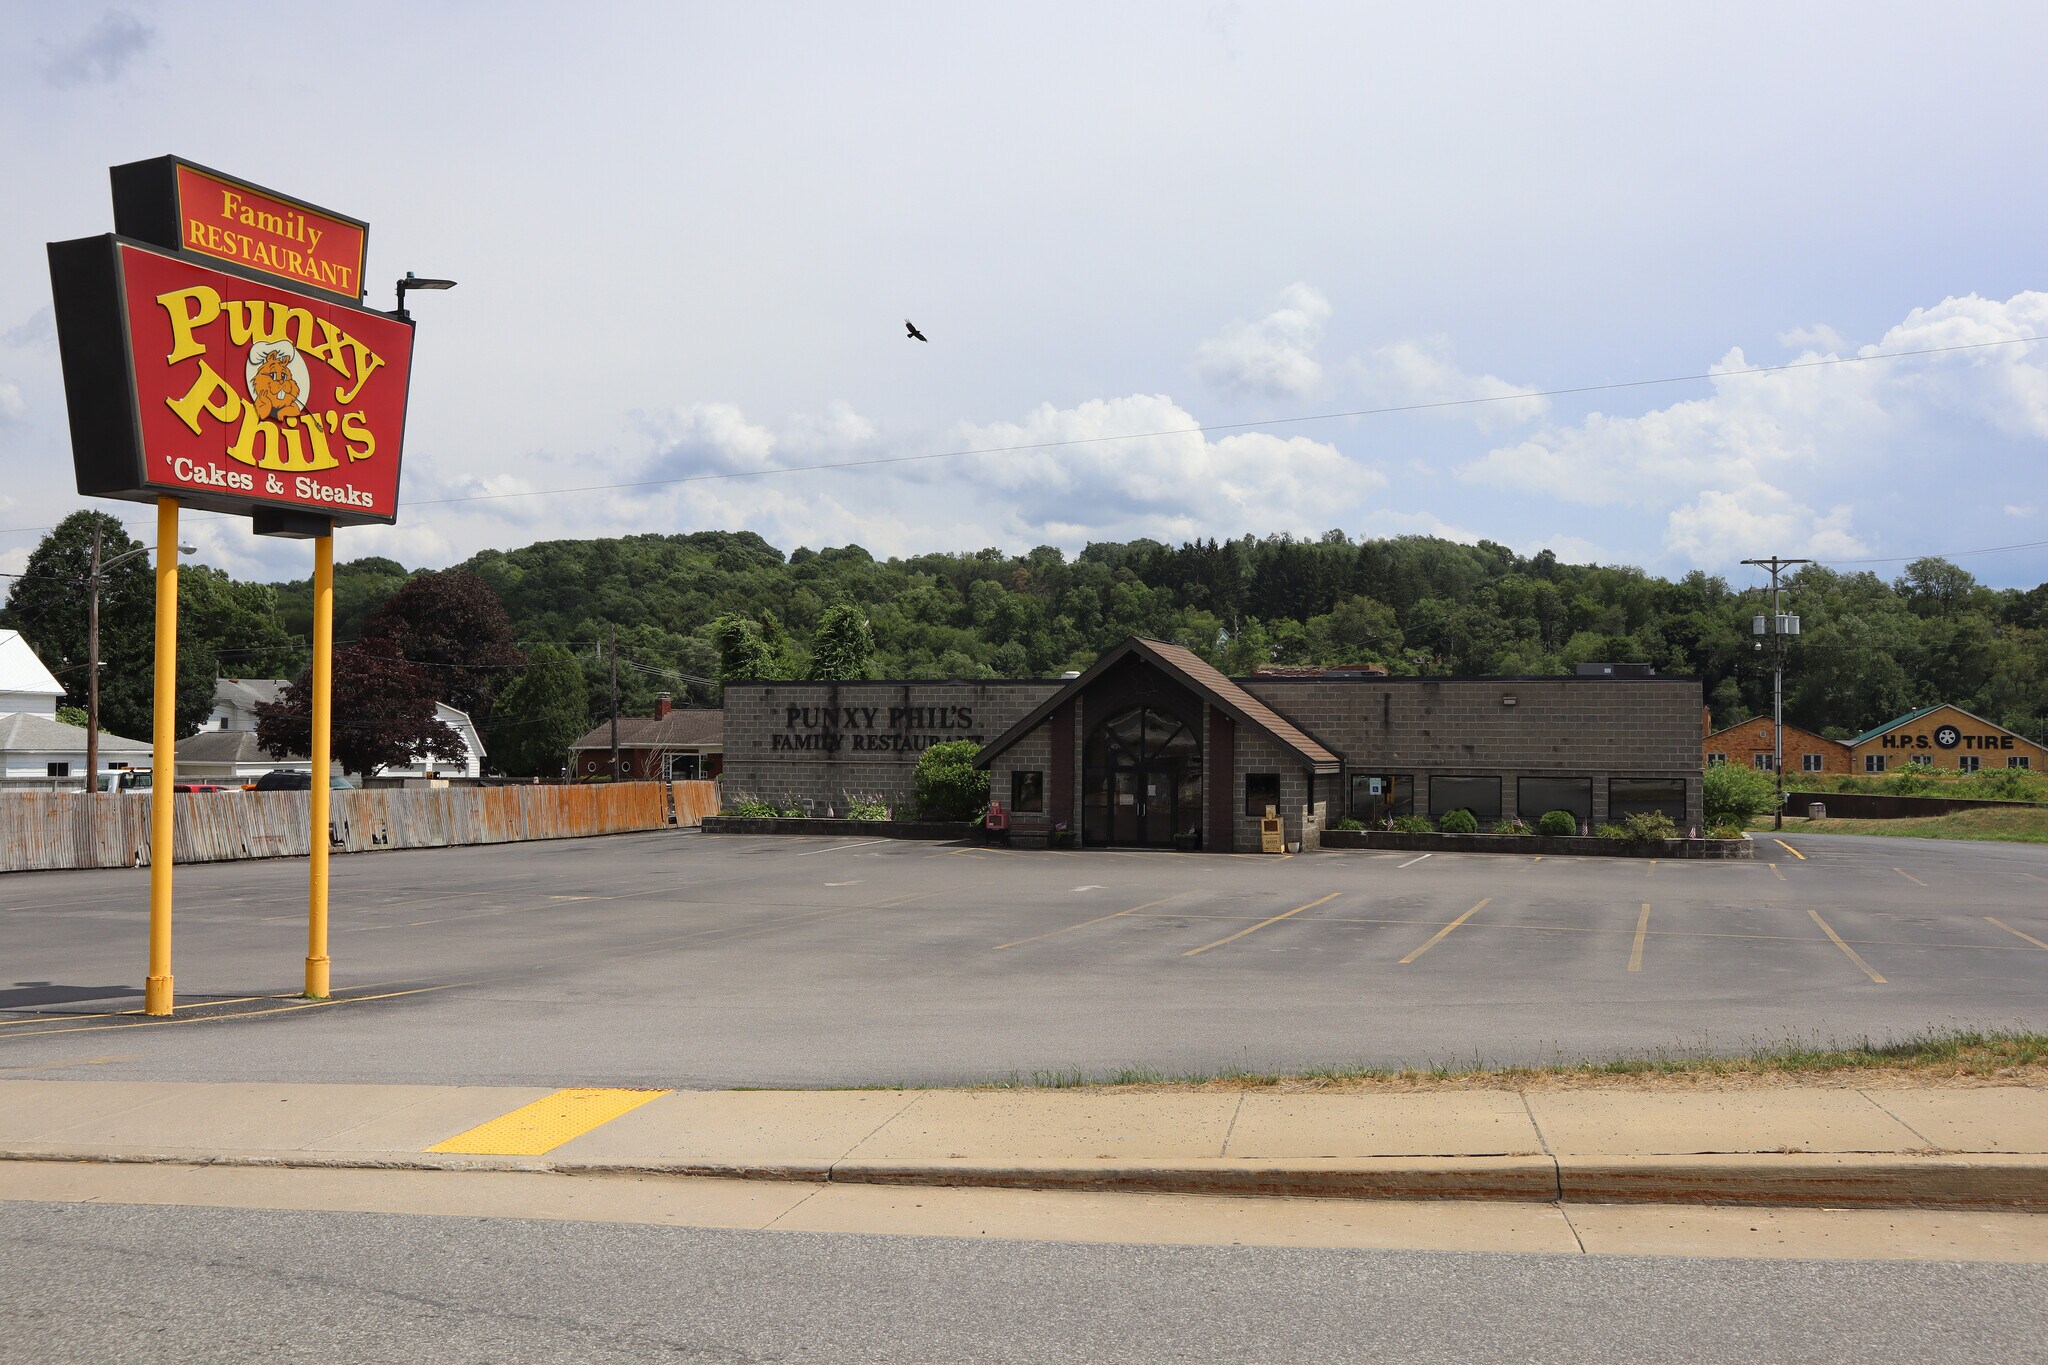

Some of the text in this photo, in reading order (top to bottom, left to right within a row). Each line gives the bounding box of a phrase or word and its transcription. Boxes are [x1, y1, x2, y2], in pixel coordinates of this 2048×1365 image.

[221, 190, 323, 254] Family
[189, 219, 352, 289] RESTAURANT
[156, 285, 385, 405] Punxy
[265, 473, 284, 496] &
[295, 475, 374, 508] Steaks
[786, 707, 973, 729] PUNXY PHIL'S
[772, 734, 985, 751] FAMILY RESTAURT
[1882, 734, 2014, 750] H.P.S. TIRE
